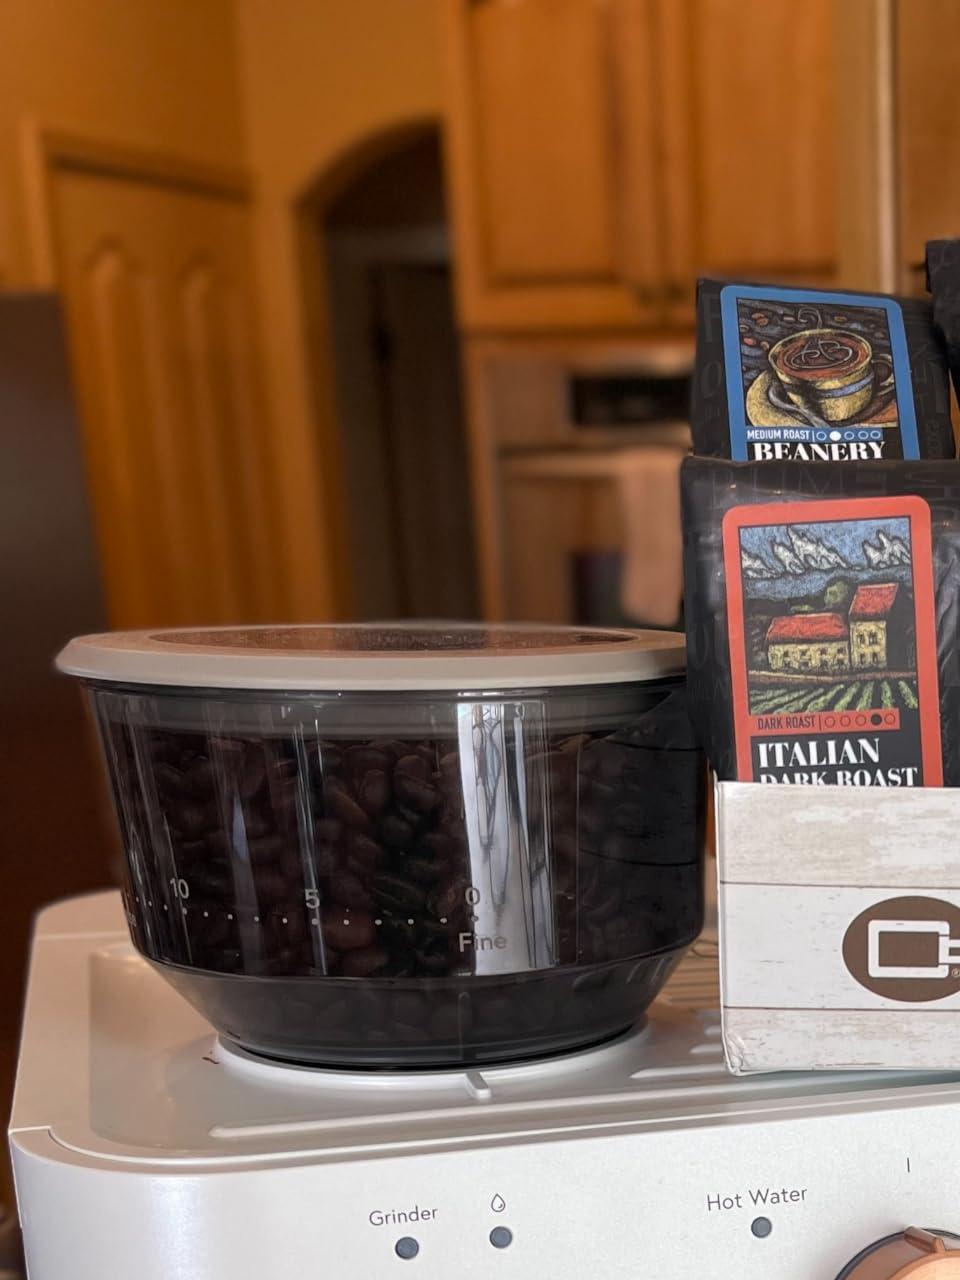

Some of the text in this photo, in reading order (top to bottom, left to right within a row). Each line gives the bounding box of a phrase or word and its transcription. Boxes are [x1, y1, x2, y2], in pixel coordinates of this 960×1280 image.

[747, 430, 810, 441] MEDIUM ROAST
[753, 441, 885, 461] BEANERY
[757, 714, 817, 731] DARK ROAST
[757, 737, 880, 769] ITALIAN
[835, 766, 919, 788] ROAST
[169, 877, 190, 900] 10
[304, 888, 321, 910] 5
[464, 887, 481, 906] 0
[458, 932, 508, 953] Fine
[706, 1187, 808, 1212] Hot Water
[368, 1205, 438, 1226] Grinder
